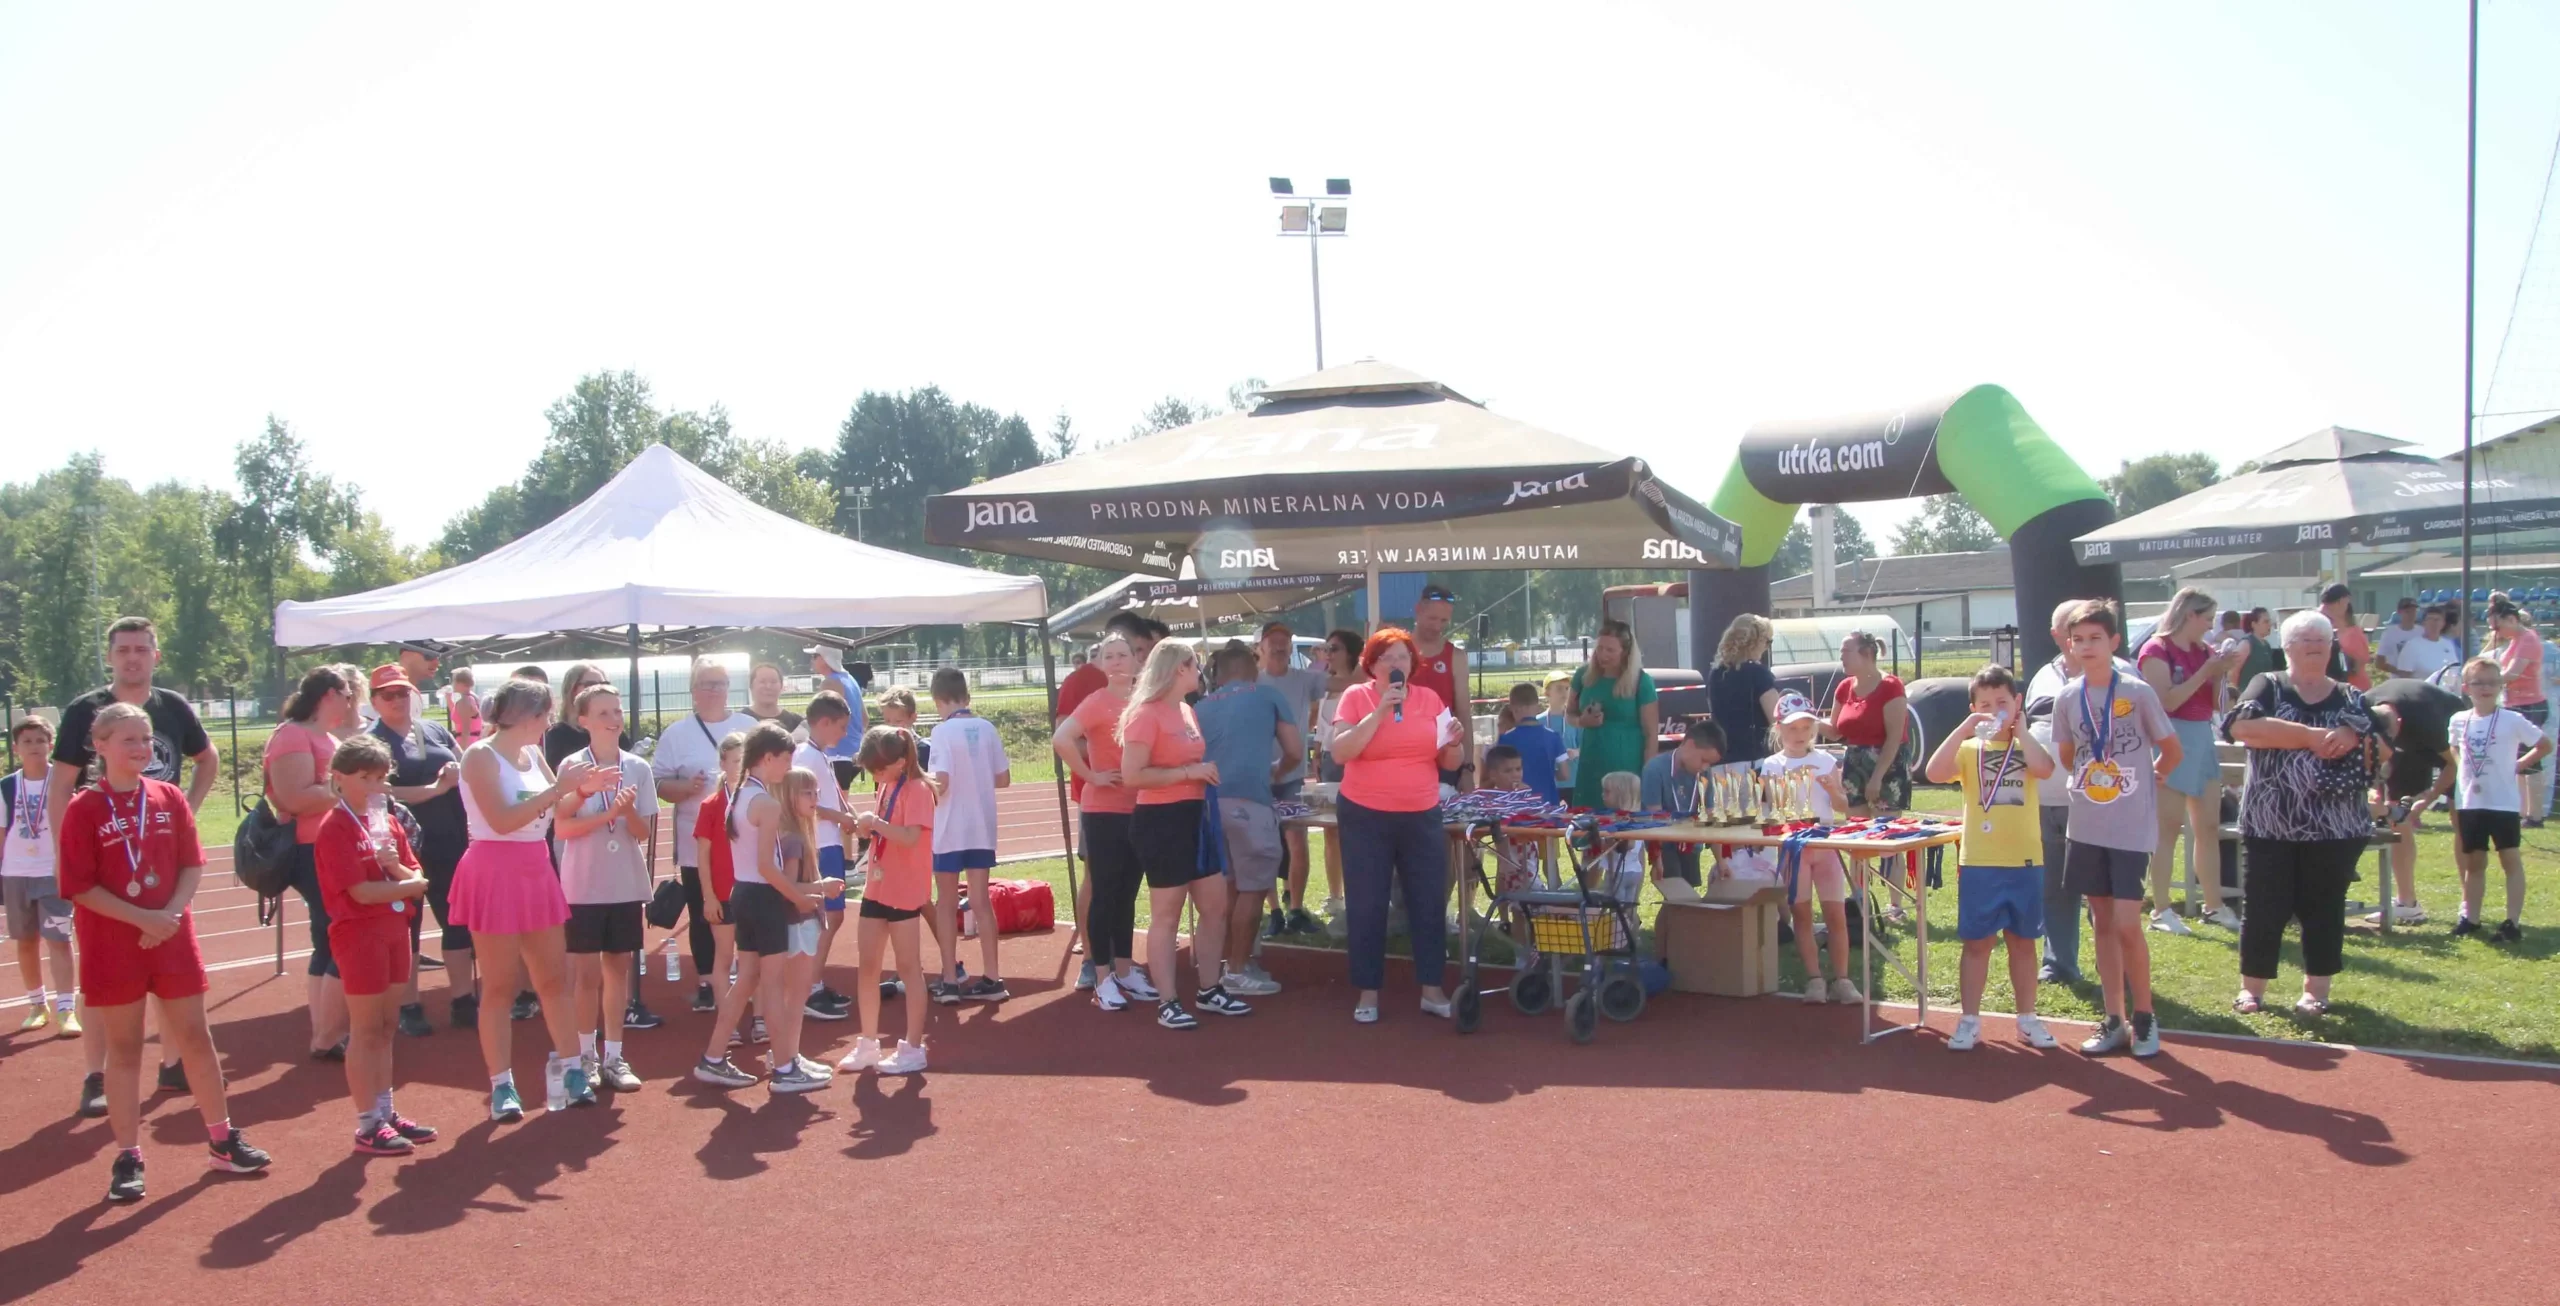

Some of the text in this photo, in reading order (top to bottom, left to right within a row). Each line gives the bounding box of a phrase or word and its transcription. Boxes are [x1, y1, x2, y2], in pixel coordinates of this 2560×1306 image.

[1778, 437, 1885, 475] utrka.com
[963, 500, 1039, 533] Jana
[1090, 491, 1446, 520] PRIRODNA MINERALNA VODA
[2294, 522, 2333, 544] Jana
[2423, 517, 2476, 531] CARBONATD
[2138, 532, 2263, 552] NATURAL MINERAL WATER
[1197, 575, 1322, 592] PRIRODNA MINERALNA VODA
